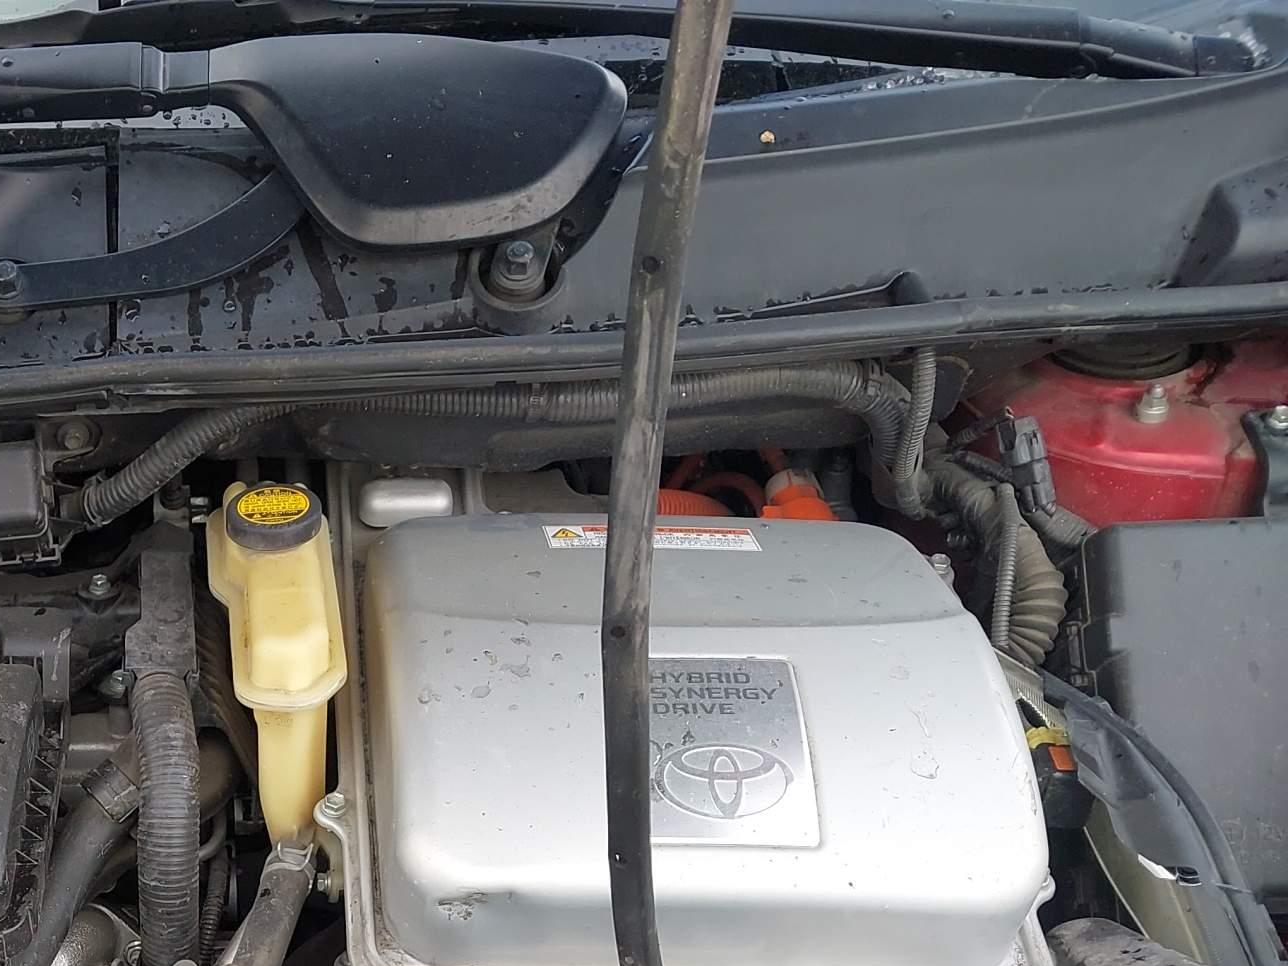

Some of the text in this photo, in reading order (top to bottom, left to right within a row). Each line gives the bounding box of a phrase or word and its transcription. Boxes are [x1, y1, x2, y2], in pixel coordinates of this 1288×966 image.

[650, 672, 750, 684] HYBRID
[650, 687, 777, 700] SYNERGY
[652, 703, 736, 715] DRIVE
